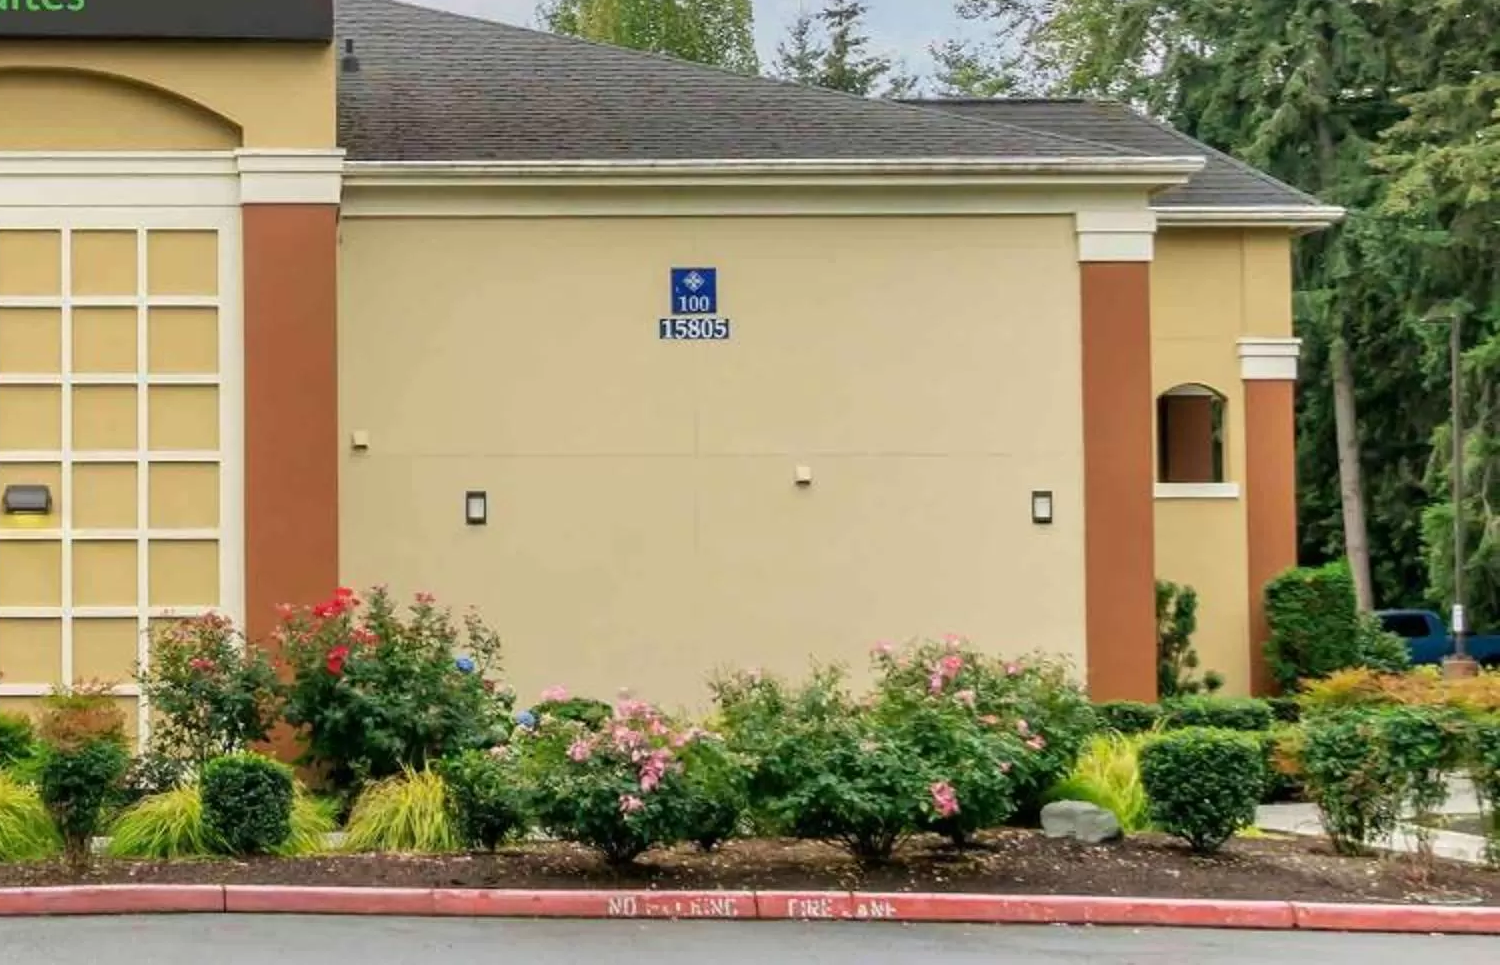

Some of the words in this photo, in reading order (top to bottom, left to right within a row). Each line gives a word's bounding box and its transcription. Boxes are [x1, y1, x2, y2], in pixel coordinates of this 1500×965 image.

[678, 295, 710, 312] 100
[661, 318, 727, 339] 15805
[608, 896, 637, 916] NO
